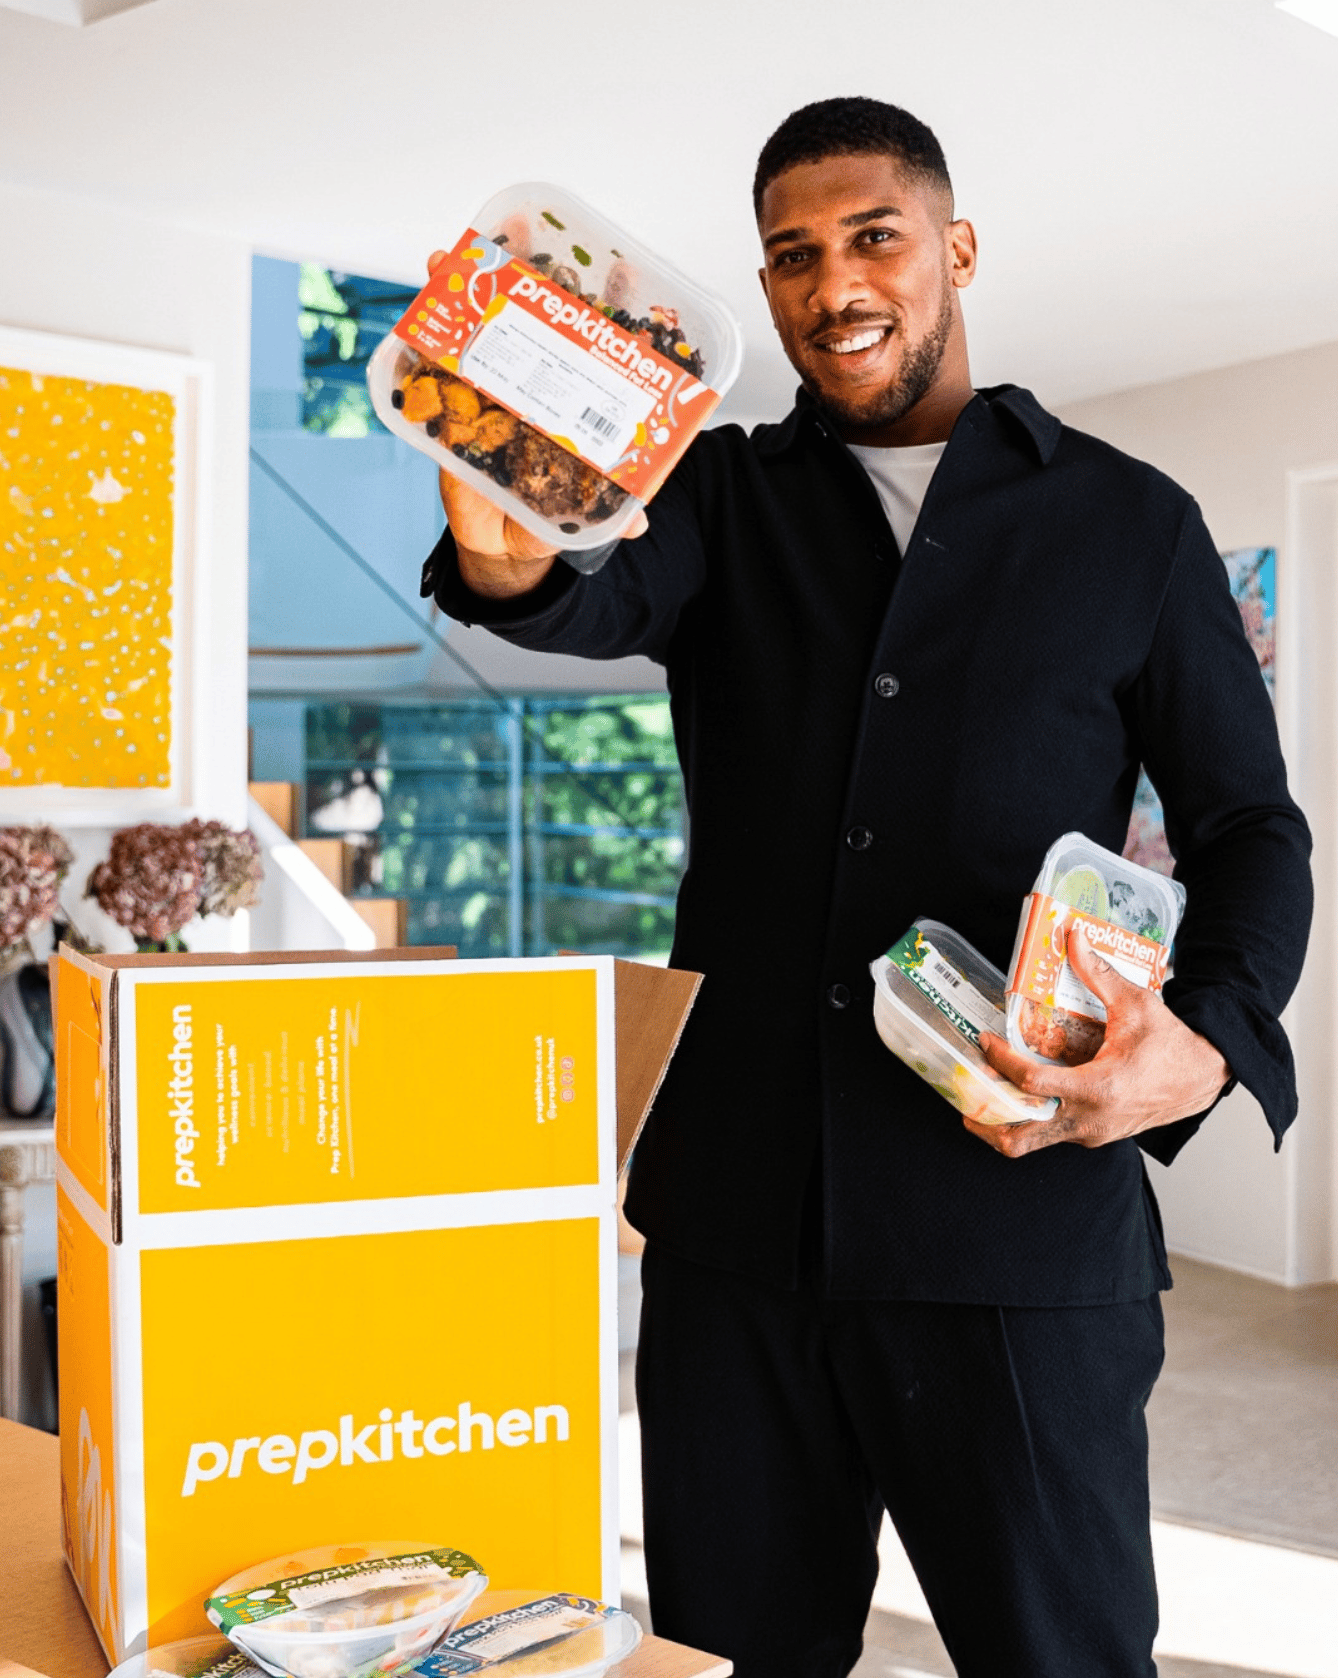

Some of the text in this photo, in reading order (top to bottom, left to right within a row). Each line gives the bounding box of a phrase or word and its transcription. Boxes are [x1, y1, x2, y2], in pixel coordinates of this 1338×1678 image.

[508, 276, 672, 391] prepkitchen
[1072, 917, 1156, 963] prepkitchen
[330, 1033, 338, 1041] a
[330, 1042, 338, 1054] at
[315, 1035, 329, 1145] Change your life with
[329, 1055, 338, 1082] meal
[534, 1035, 545, 1124] prepkitchen.co.uk
[167, 1004, 201, 1188] prepkitchen
[215, 1023, 227, 1166] helping you to achieve your
[228, 1044, 241, 1144] wellness goals with
[331, 1084, 339, 1104] one
[330, 1105, 340, 1147] Kitchen,
[330, 1149, 341, 1174] Prep
[181, 1401, 569, 1497] prepkitchen
[280, 1555, 432, 1589] prepkitchen
[444, 1600, 559, 1648] prepkitchen
